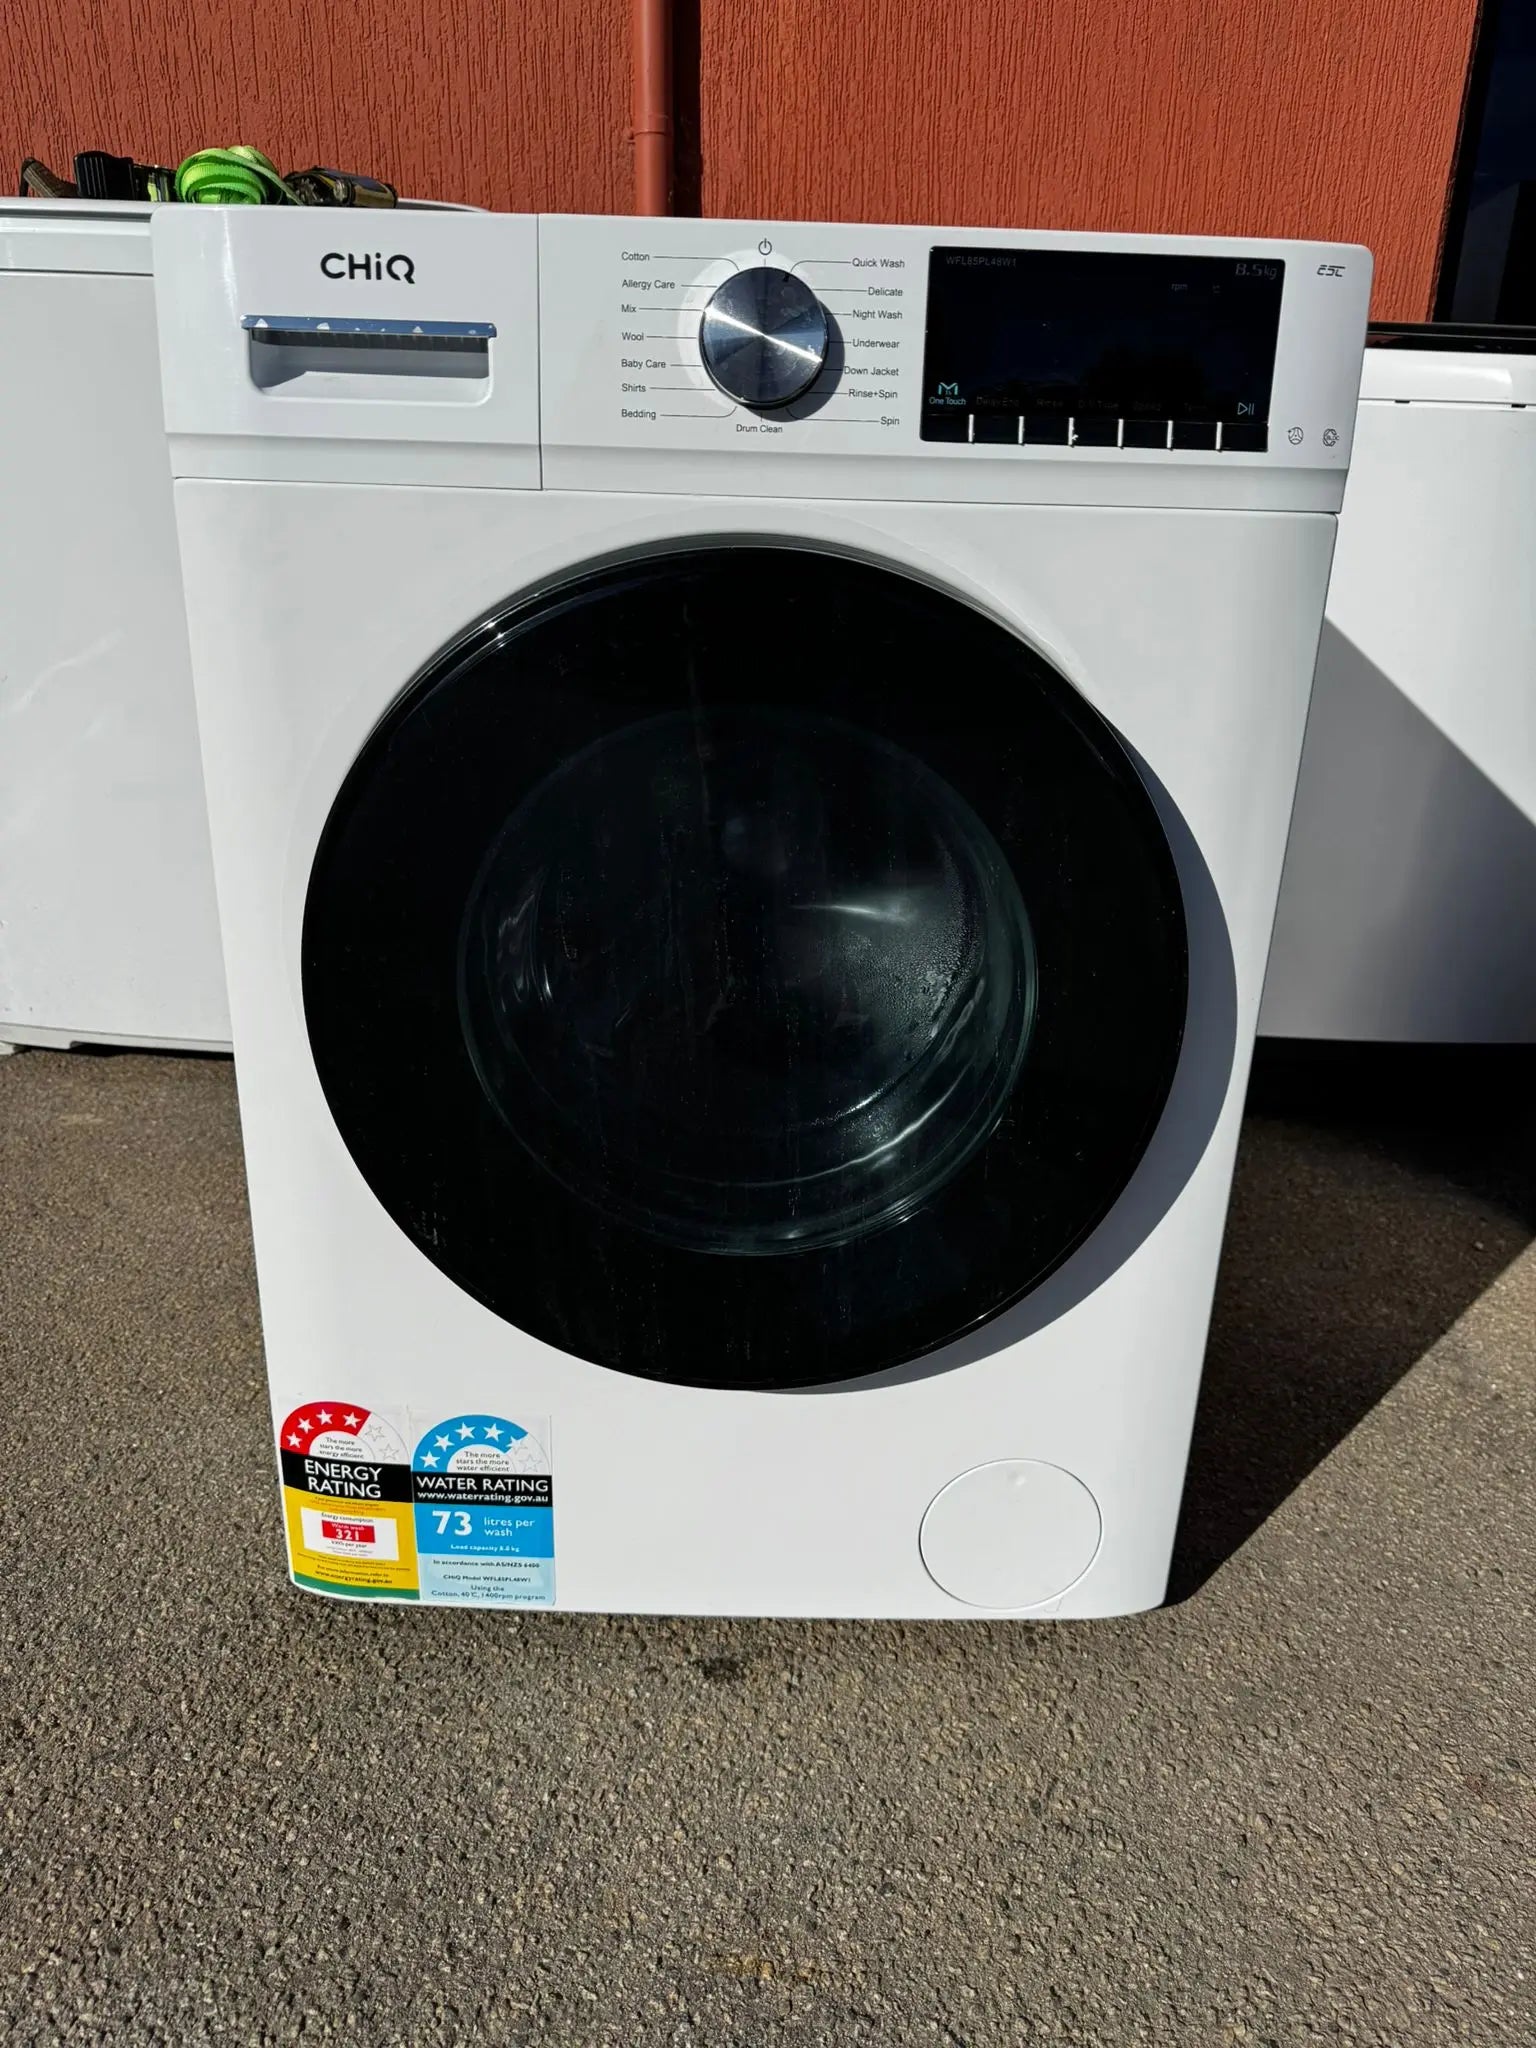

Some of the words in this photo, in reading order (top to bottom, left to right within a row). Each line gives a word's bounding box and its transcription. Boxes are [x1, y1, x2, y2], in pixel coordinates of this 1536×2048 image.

[621, 251, 650, 261] Cotton
[320, 252, 415, 284] CHiQ
[852, 257, 878, 268] Quick
[880, 258, 905, 268] Wash
[621, 279, 652, 290] Allergy
[654, 280, 675, 289] Care
[868, 286, 903, 297] Delicate
[621, 304, 637, 312] Mix
[852, 309, 876, 320] Night
[878, 310, 903, 319] Wash
[621, 332, 644, 341] Wool
[852, 339, 900, 348] Underwear
[621, 359, 643, 369] Baby
[645, 359, 666, 368] Care
[844, 366, 868, 375] Down
[870, 367, 899, 376] Jacket
[621, 383, 647, 392] Shirts
[848, 388, 898, 400] Rinse+Spin
[929, 396, 945, 405] One
[946, 396, 967, 405] Touch
[621, 408, 656, 420] Bedding
[880, 416, 900, 427] Spin
[736, 423, 758, 433] Drum
[760, 424, 783, 433] Clean
[464, 1450, 479, 1458] The
[304, 1458, 383, 1482] ENERGY
[307, 1476, 381, 1498] RATING
[416, 1475, 478, 1491] WATER
[482, 1478, 549, 1492] RATING
[417, 1491, 549, 1504] www.waterrating.gov.au
[321, 1512, 339, 1520] Energy
[431, 1510, 473, 1536] 73
[483, 1516, 513, 1527] litres
[515, 1519, 535, 1529] per
[335, 1528, 359, 1541] 321
[484, 1527, 513, 1537] wash
[470, 1584, 492, 1592] Using
[431, 1590, 460, 1598] Cotton,
[514, 1593, 546, 1601] program
